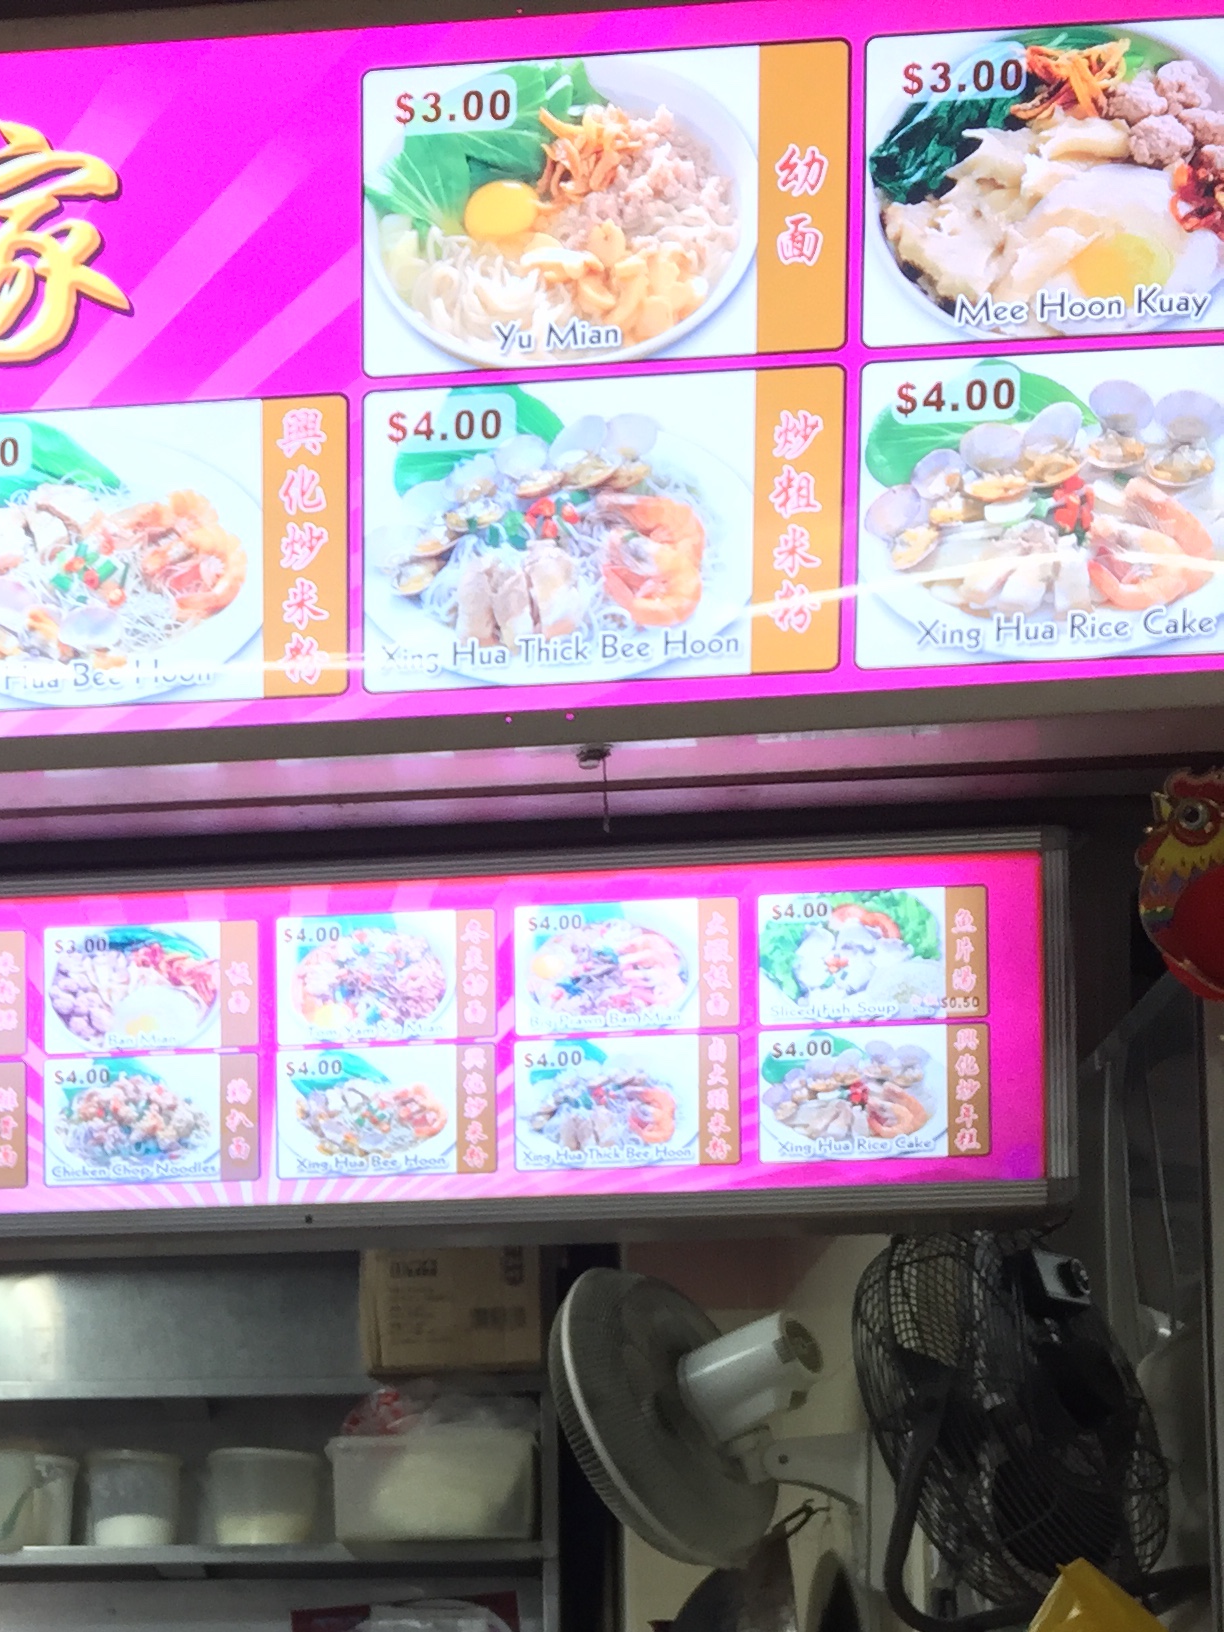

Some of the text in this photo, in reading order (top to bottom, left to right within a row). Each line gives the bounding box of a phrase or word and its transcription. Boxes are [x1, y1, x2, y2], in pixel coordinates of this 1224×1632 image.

[901, 57, 1025, 97] $3.00
[394, 89, 513, 126] $3.00
[775, 143, 829, 267] 幼面
[956, 284, 1211, 327] Mee Hoon Kuay
[494, 321, 622, 354] Yu Mian
[895, 378, 1016, 417] $4.00
[386, 408, 502, 445] $4.00
[917, 607, 1216, 650] Xing Hua Rice Cake
[452, 640, 507, 666] Hua
[519, 634, 589, 663] Thick
[600, 634, 650, 660] Bee
[663, 629, 740, 657] Hoon
[770, 902, 828, 920] $4.00
[527, 914, 582, 931] $4.00
[283, 927, 340, 943] $4.00
[54, 938, 107, 953] $3.00
[857, 1003, 896, 1015] Soup
[940, 996, 980, 1009] $0.50
[772, 1040, 832, 1057] $4.00
[286, 1060, 343, 1076] $4.00
[524, 1051, 582, 1067] $4.00
[54, 1069, 110, 1085] $4.00
[556, 1150, 584, 1161] Hua
[588, 1148, 621, 1159] Thick
[626, 1147, 650, 1158] Bee
[655, 1145, 692, 1157] Hoon
[778, 1138, 932, 1154] Xing Hua Rice Cake
[52, 1161, 217, 1179] Chicken Chop Noodles
[297, 1153, 446, 1172] Xing Hua Bee Hoon
